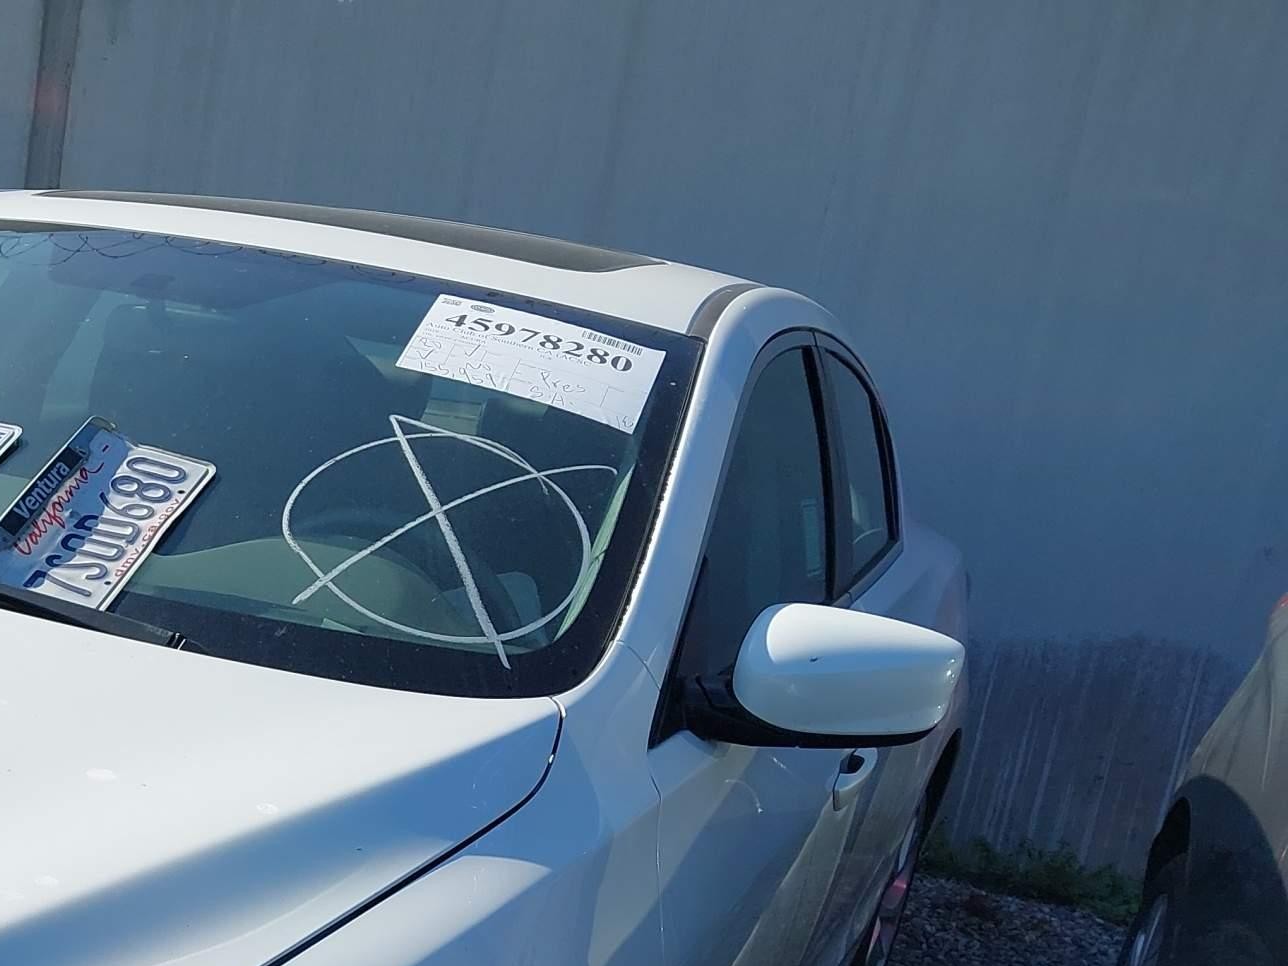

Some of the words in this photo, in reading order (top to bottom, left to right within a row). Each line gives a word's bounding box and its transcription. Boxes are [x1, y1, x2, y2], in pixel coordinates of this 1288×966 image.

[445, 314, 633, 372] 45978280
[453, 325, 476, 336] Club
[492, 336, 535, 351] Southern
[14, 460, 72, 519] Ventura
[15, 462, 104, 556] California
[115, 498, 181, 579] dmv.ca.gov
